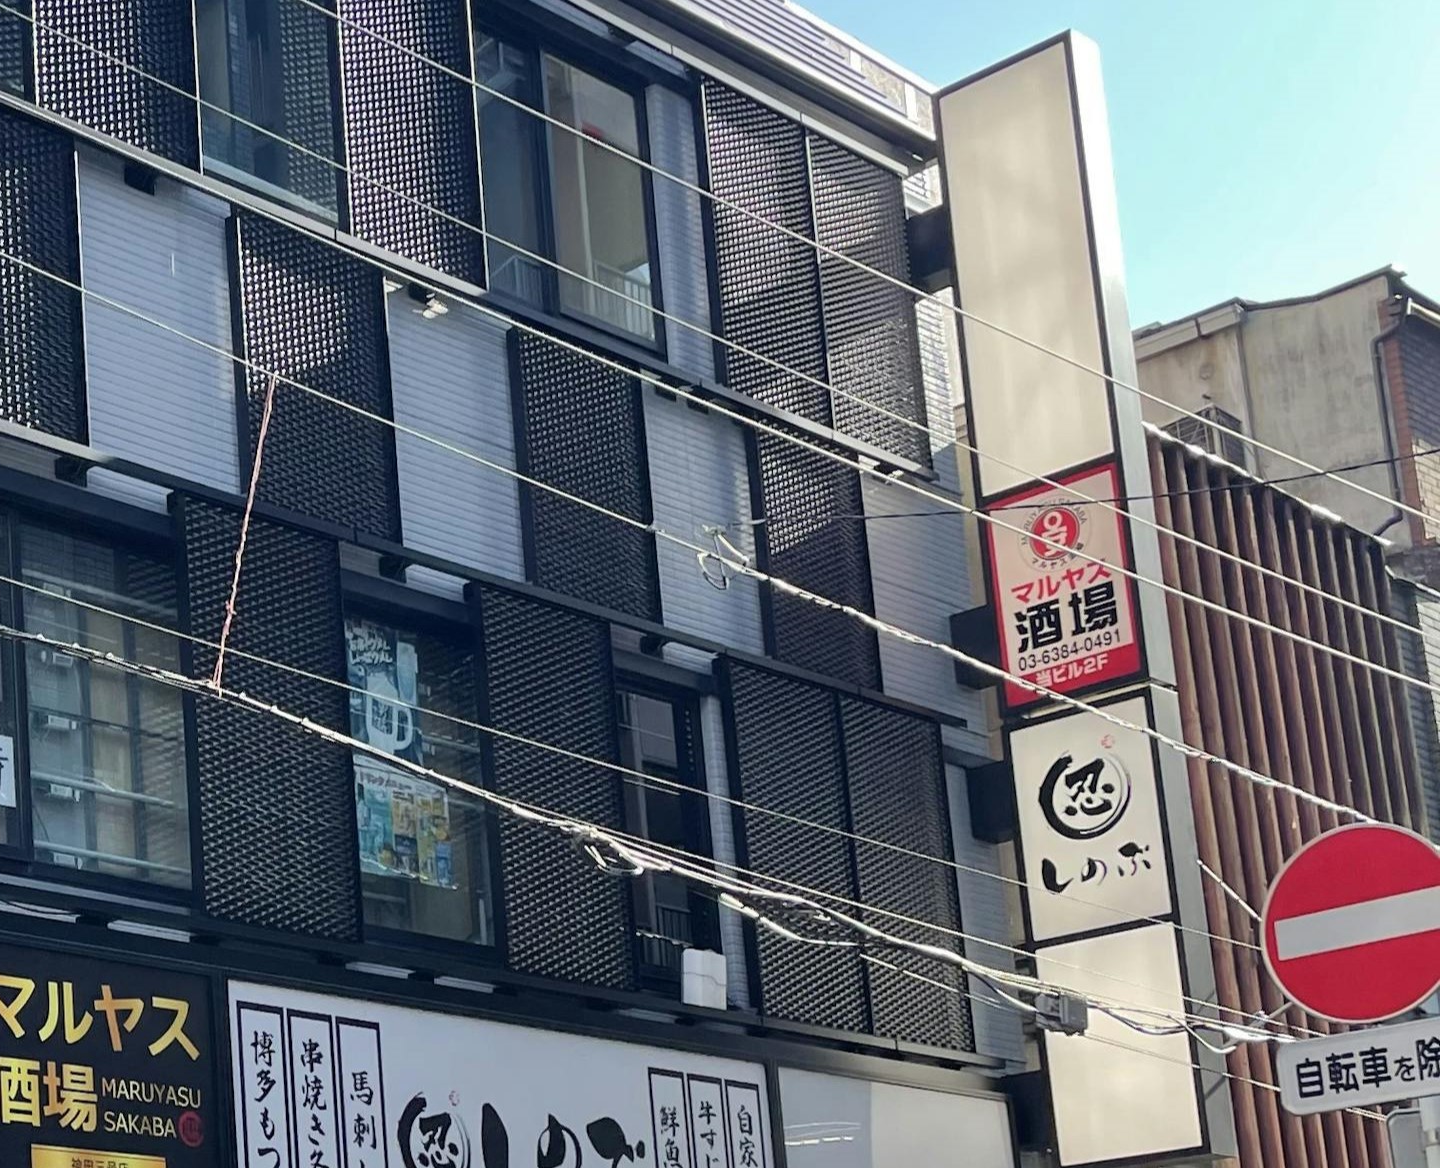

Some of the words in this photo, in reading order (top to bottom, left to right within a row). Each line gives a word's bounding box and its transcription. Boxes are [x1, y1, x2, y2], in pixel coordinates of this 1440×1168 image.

[1010, 556, 1112, 605] マルヤス
[1016, 580, 1119, 654] 酒場
[1018, 631, 1122, 671] 03-6384-0491
[1034, 654, 1110, 688] 当ビル2F
[1041, 841, 1153, 894] しのぶ
[101, 1077, 201, 1109] MARUYASU
[103, 1111, 178, 1138] SAKABA
